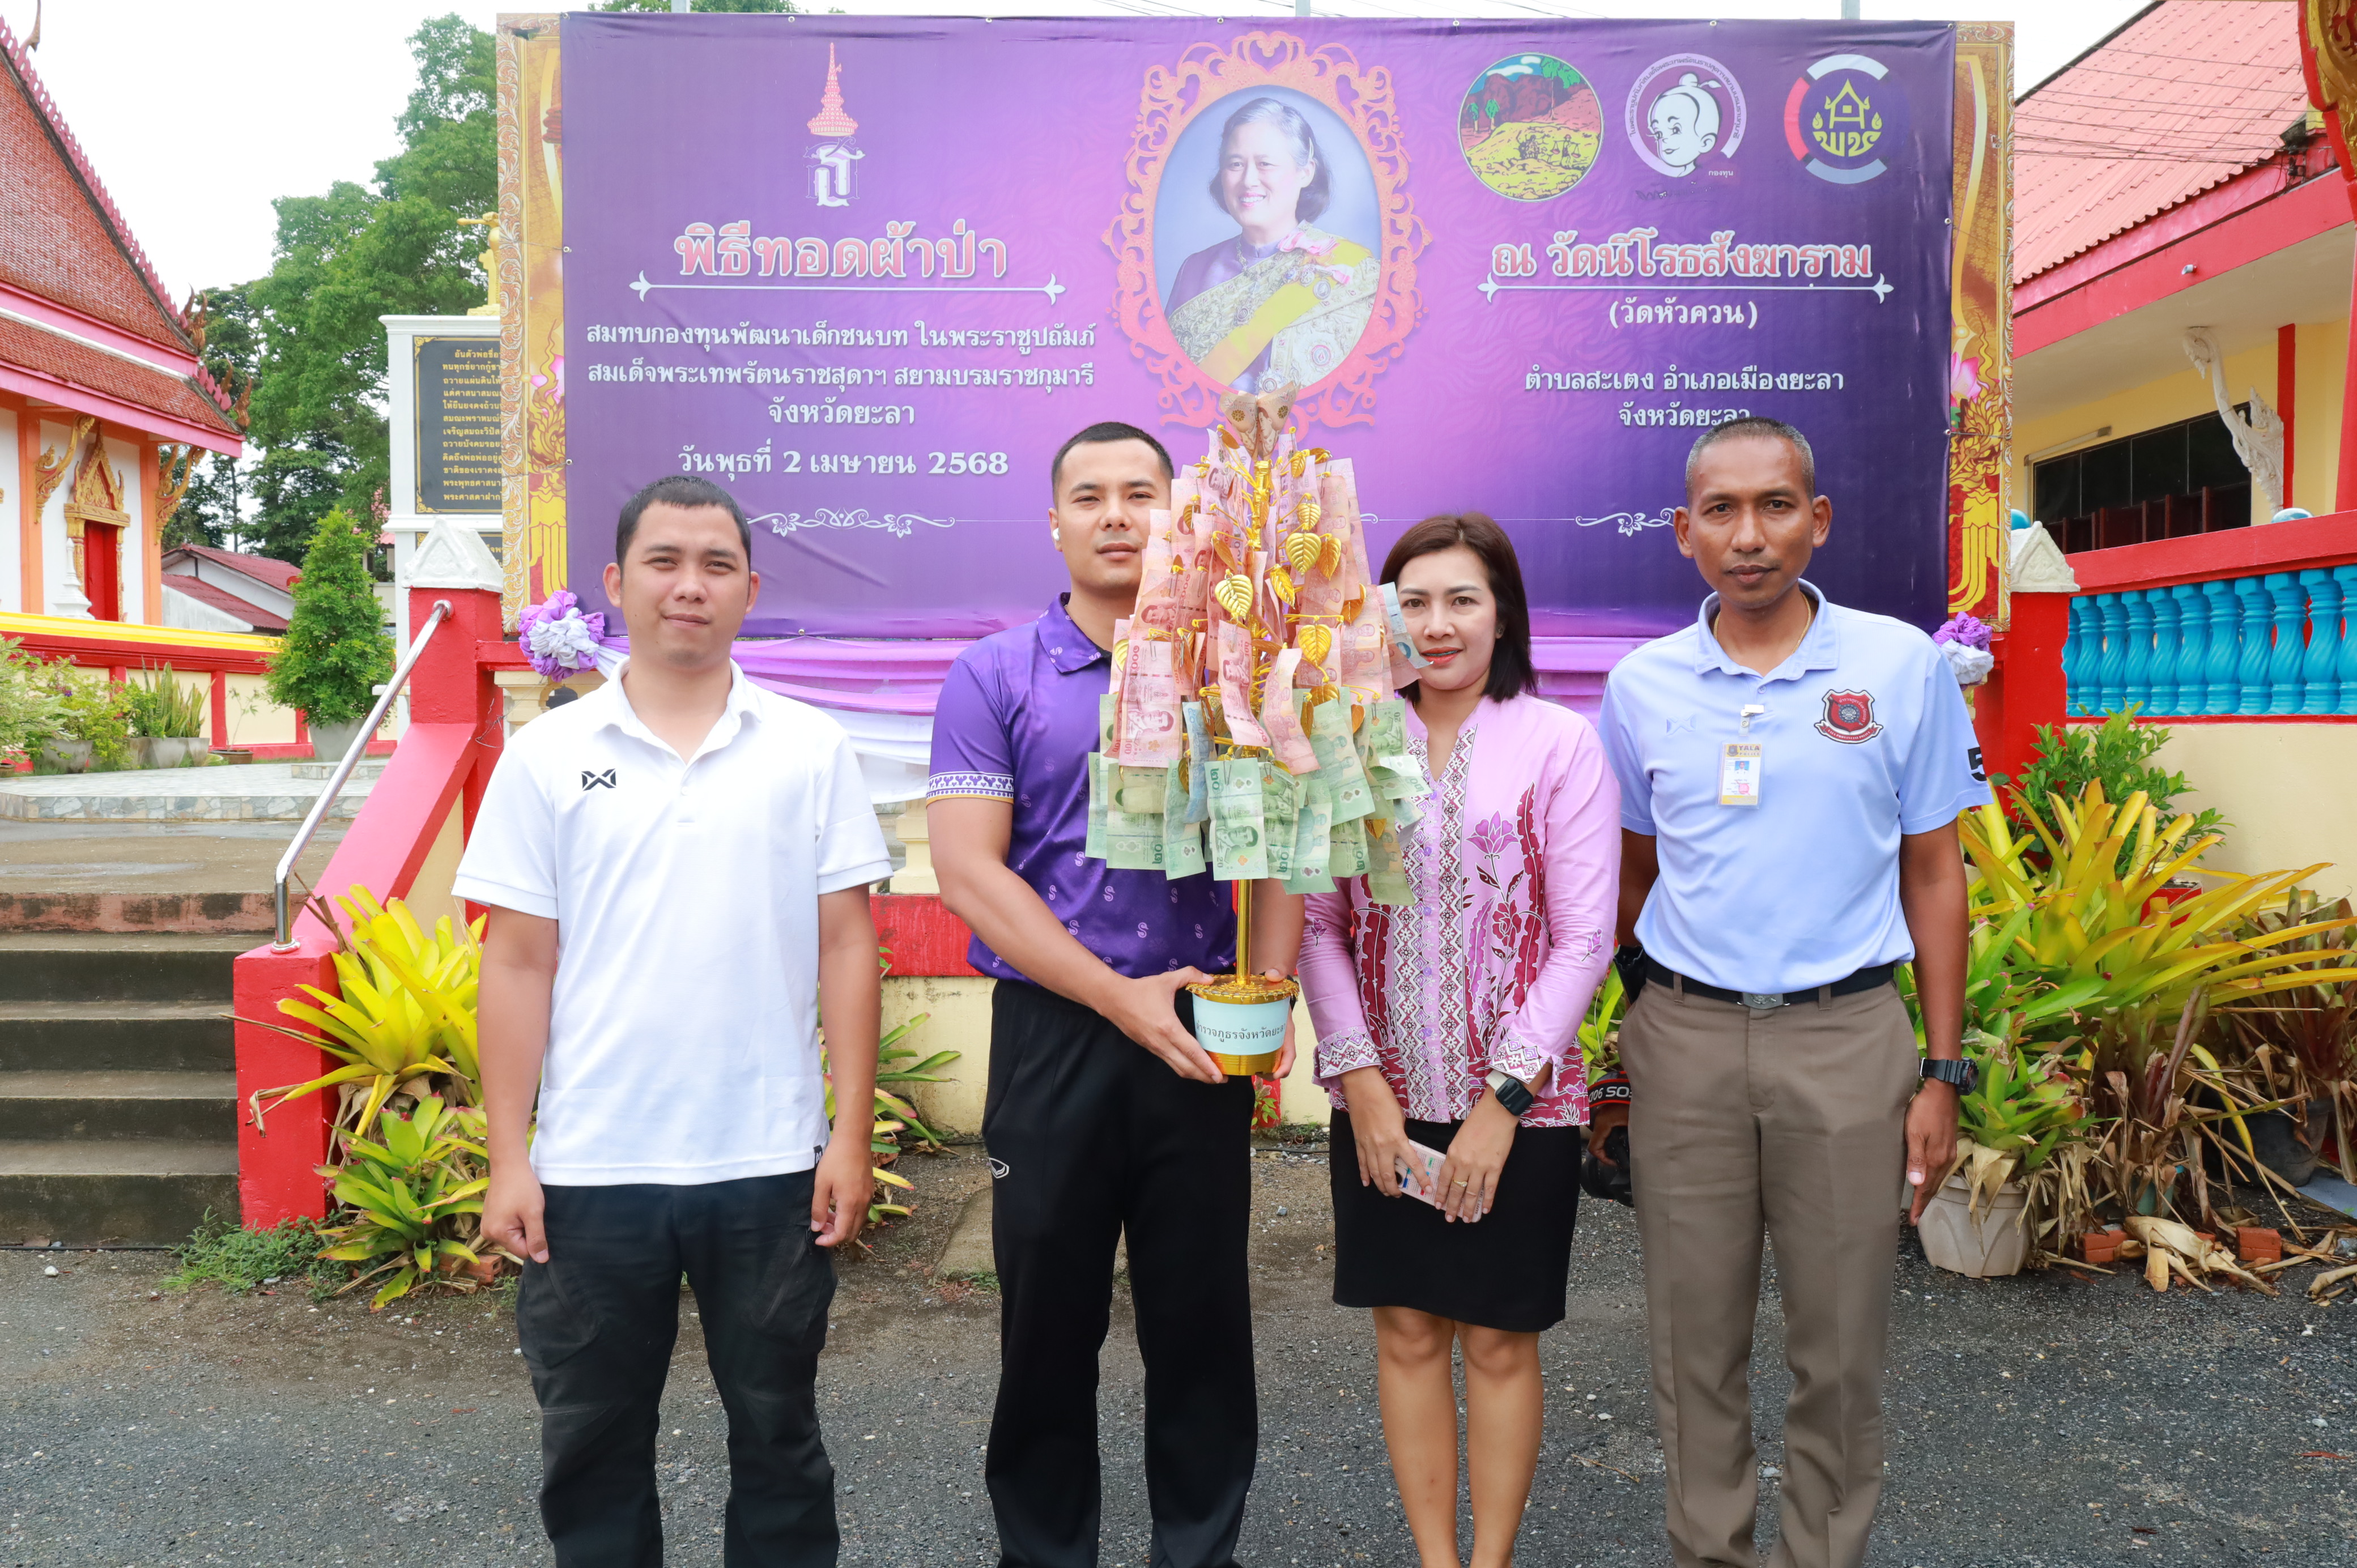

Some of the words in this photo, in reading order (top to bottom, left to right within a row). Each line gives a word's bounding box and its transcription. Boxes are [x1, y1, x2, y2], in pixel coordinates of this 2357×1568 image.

[674, 219, 1007, 279] พิธีทอดผ้าป่า
[1492, 242, 1535, 276] ณ
[1546, 227, 1872, 277] วัดนิโรธสังฆาราม
[1609, 297, 1758, 329] (วัดหัวควน)
[586, 321, 908, 353] สมทบกองทุนพัฒนาเด็กชนบท
[913, 320, 1096, 355] ในพระราชูปถัมภ์
[454, 348, 500, 357] อันตัวพ่อชื่อ
[588, 357, 887, 393] สมเด็จพระเทพรัตนราชสุดาฯ
[894, 362, 1095, 393] สยามบรมราชกุมารี
[1525, 365, 1654, 391] ตำบลสะเตง
[1663, 365, 1843, 391] อำเภอเมืองยะลา
[443, 399, 501, 409] ให้ยืนยงคงถ้วน
[768, 397, 915, 425] จังหวัดยะลา
[678, 438, 772, 482] วันพุธที่
[782, 450, 801, 474] 2
[810, 452, 916, 476] เมษายน
[928, 451, 1009, 475] 2568
[1131, 645, 1140, 670] ๑๐๐
[1394, 711, 1401, 723] 20
[1210, 768, 1219, 790] ๒๐
[1152, 844, 1162, 864] ๒๐
[1216, 857, 1224, 868] 20
[1277, 851, 1289, 873] ๒๐
[1355, 850, 1365, 872] ๒๐
[1196, 1020, 1286, 1042] ตำรวจภูธรจังหวัดยะลา
[1606, 1086, 1632, 1098] OS
